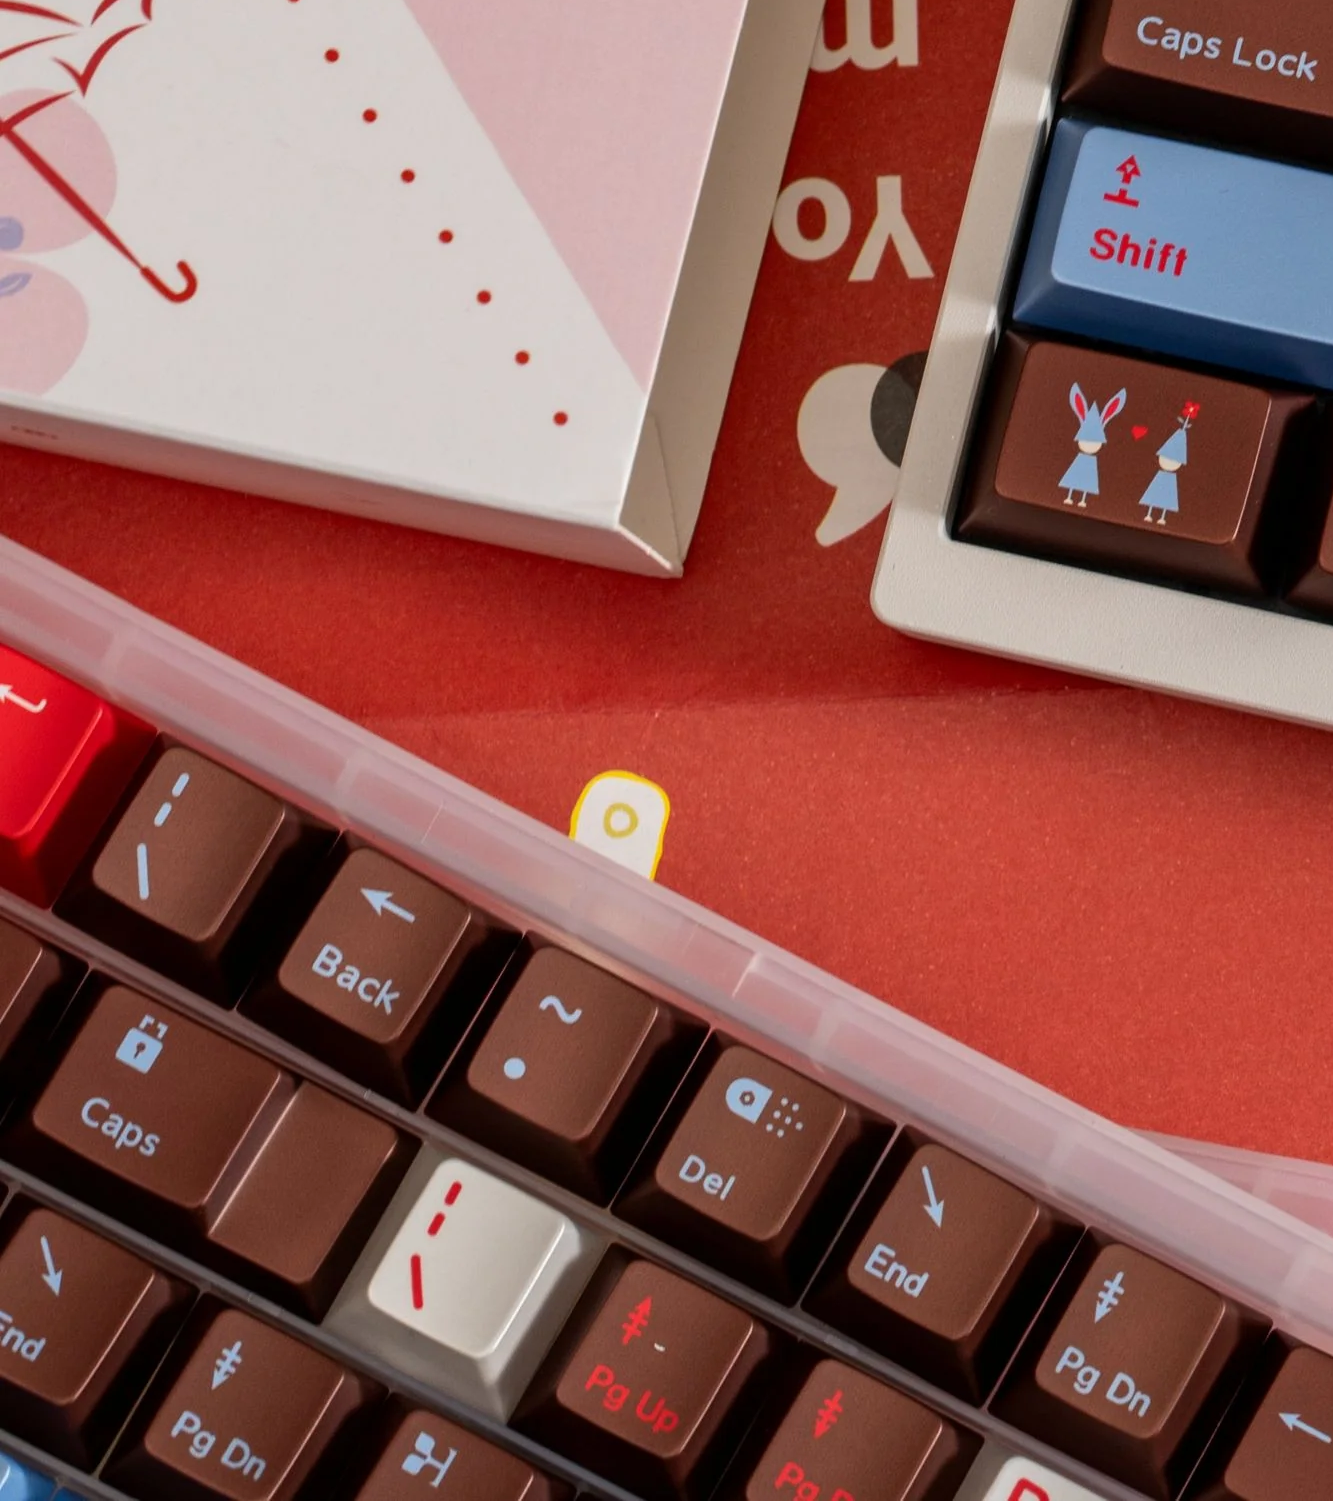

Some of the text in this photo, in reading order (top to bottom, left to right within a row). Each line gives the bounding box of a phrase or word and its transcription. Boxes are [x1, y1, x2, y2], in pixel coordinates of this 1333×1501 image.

[1138, 17, 1316, 80] Caps Lock
[1090, 228, 1186, 275] Shift
[313, 945, 398, 1012] Back
[82, 1099, 159, 1154] Caps
[680, 1156, 734, 1199] Del
[865, 1244, 928, 1296] End
[585, 1362, 680, 1436] Pg Up
[1055, 1344, 1153, 1418] Pg Dn
[171, 1410, 266, 1481] Pg Dn
